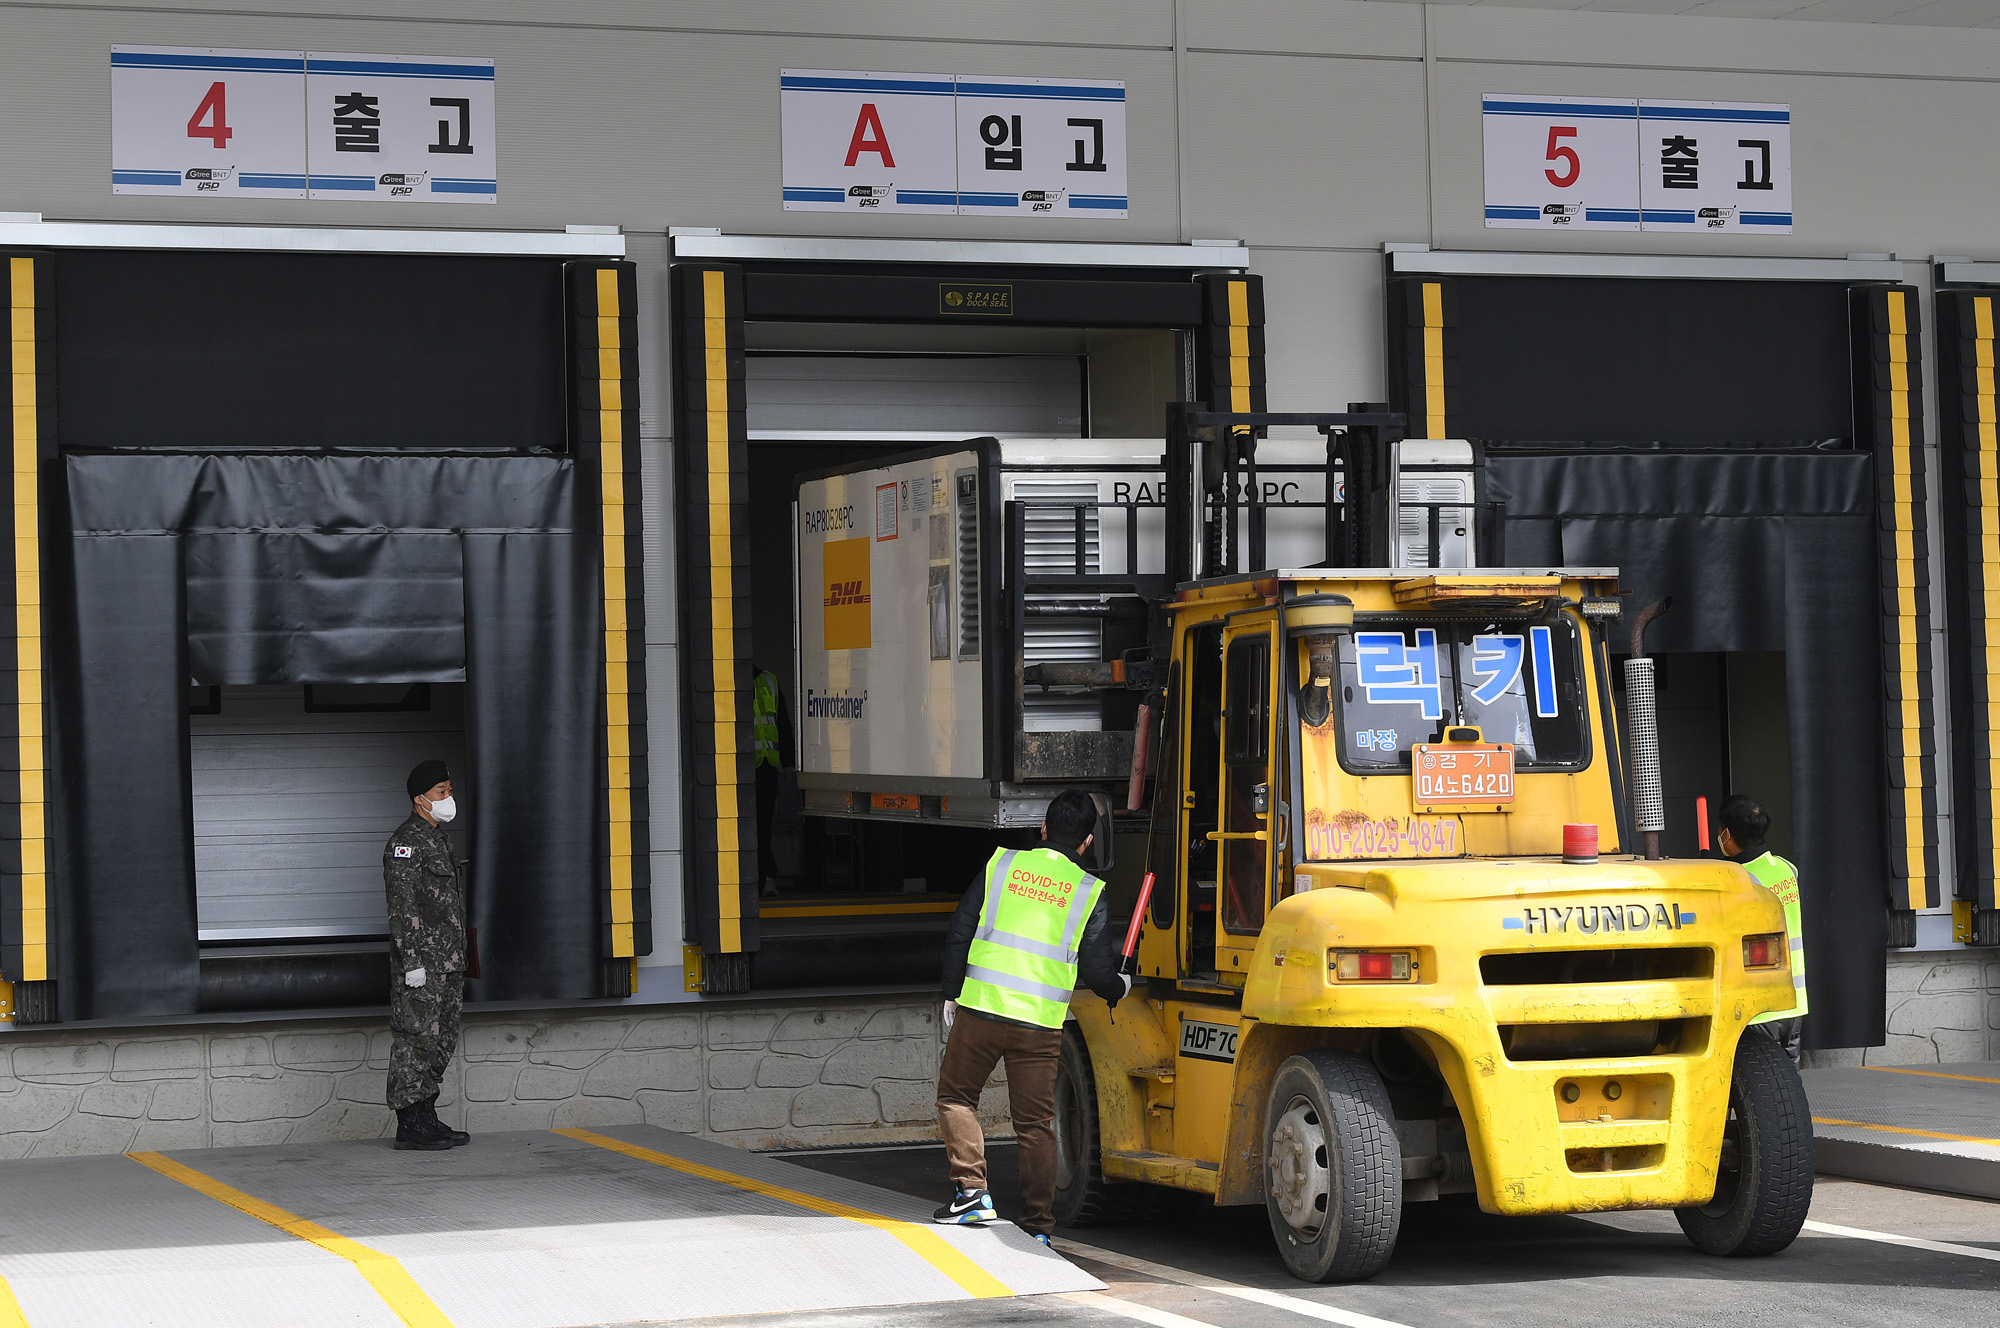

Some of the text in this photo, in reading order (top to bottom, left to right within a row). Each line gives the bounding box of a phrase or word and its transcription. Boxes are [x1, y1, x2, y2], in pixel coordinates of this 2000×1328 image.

[187, 81, 233, 149] 4
[844, 103, 896, 168] A
[1544, 126, 1580, 188] 5
[966, 291, 1008, 301] SPACE
[989, 300, 1009, 308] SEAL
[805, 505, 854, 534] RAP80529PC
[829, 581, 865, 605] DHL
[1356, 728, 1397, 751] 마장
[1421, 773, 1509, 795] 04노6420
[1309, 819, 1457, 855] 010-2025-4847
[1012, 869, 1073, 894] COVID-19
[1008, 882, 1067, 908] 백신안전수송
[1523, 903, 1682, 935] HYUNDAI
